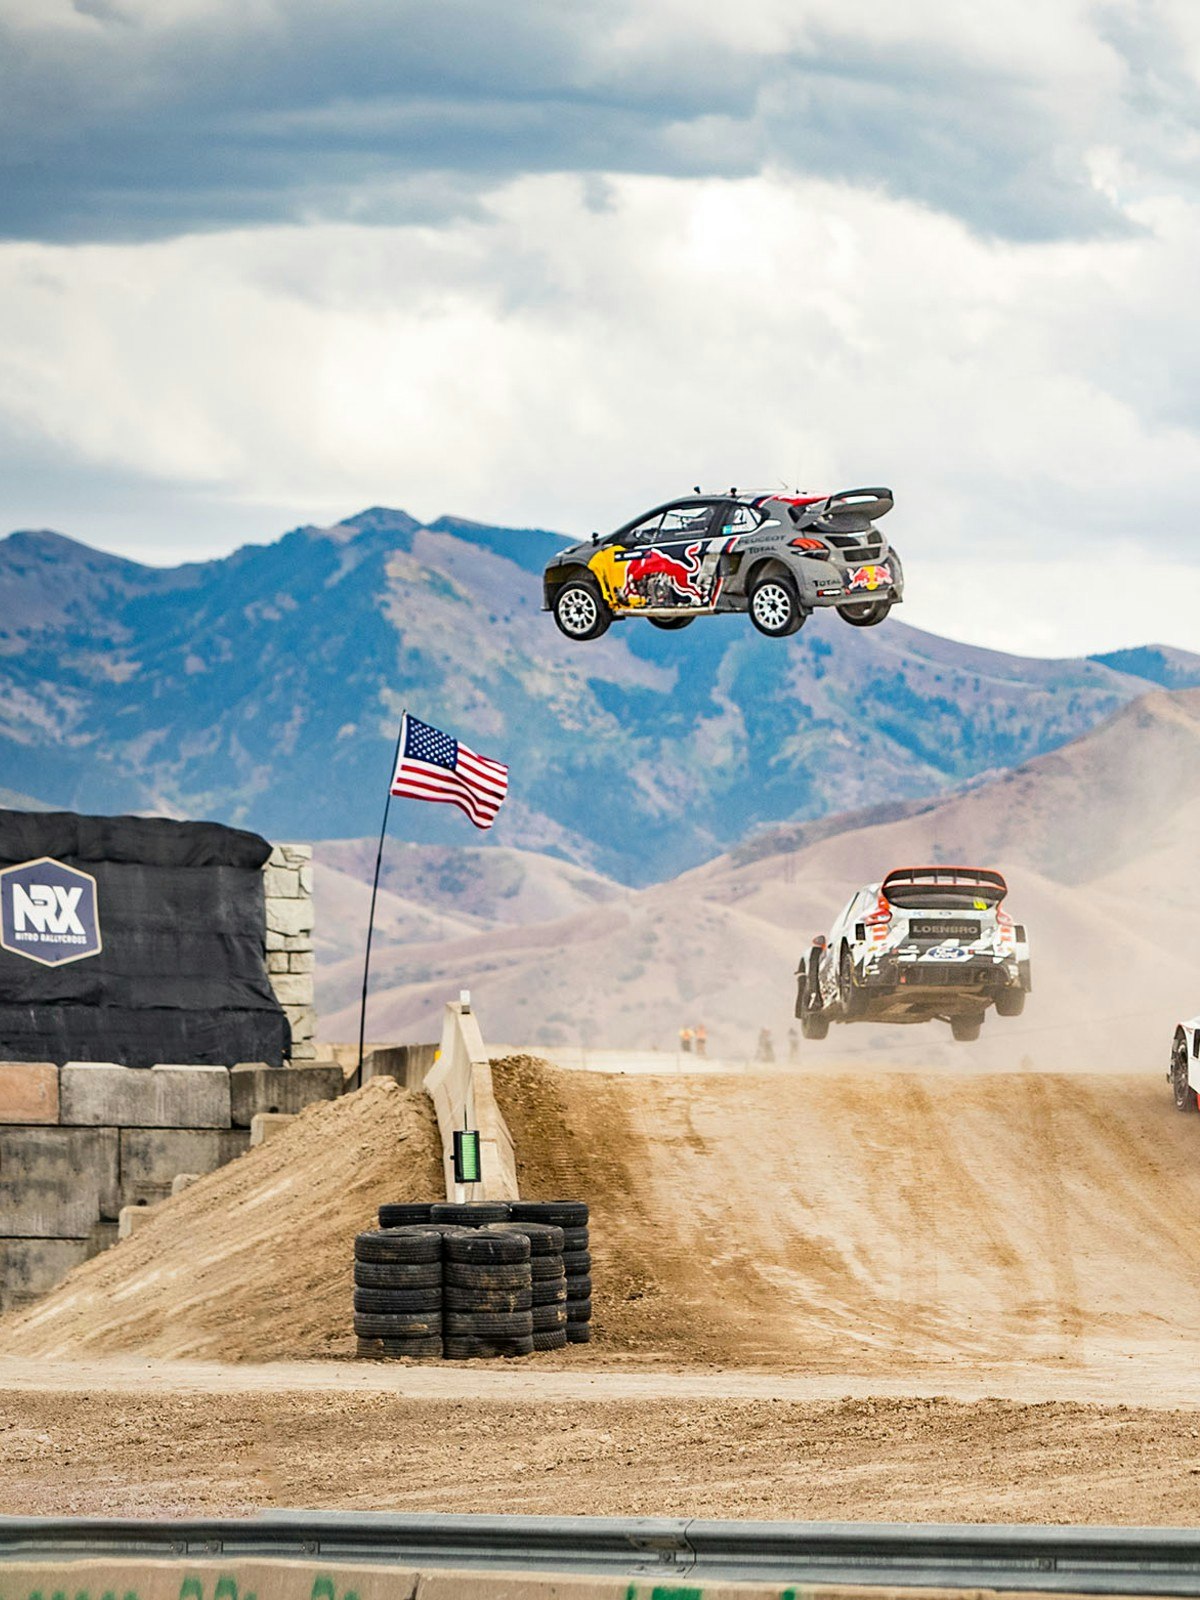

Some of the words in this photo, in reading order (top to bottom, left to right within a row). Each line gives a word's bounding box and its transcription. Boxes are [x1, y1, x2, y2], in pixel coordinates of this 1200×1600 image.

[748, 546, 777, 554] TOTAL
[813, 579, 842, 588] TOTAL
[13, 883, 87, 935] NRX
[912, 925, 979, 934] LOENBRO
[15, 932, 39, 942] NITRO
[41, 934, 88, 945] RALLYCROSS
